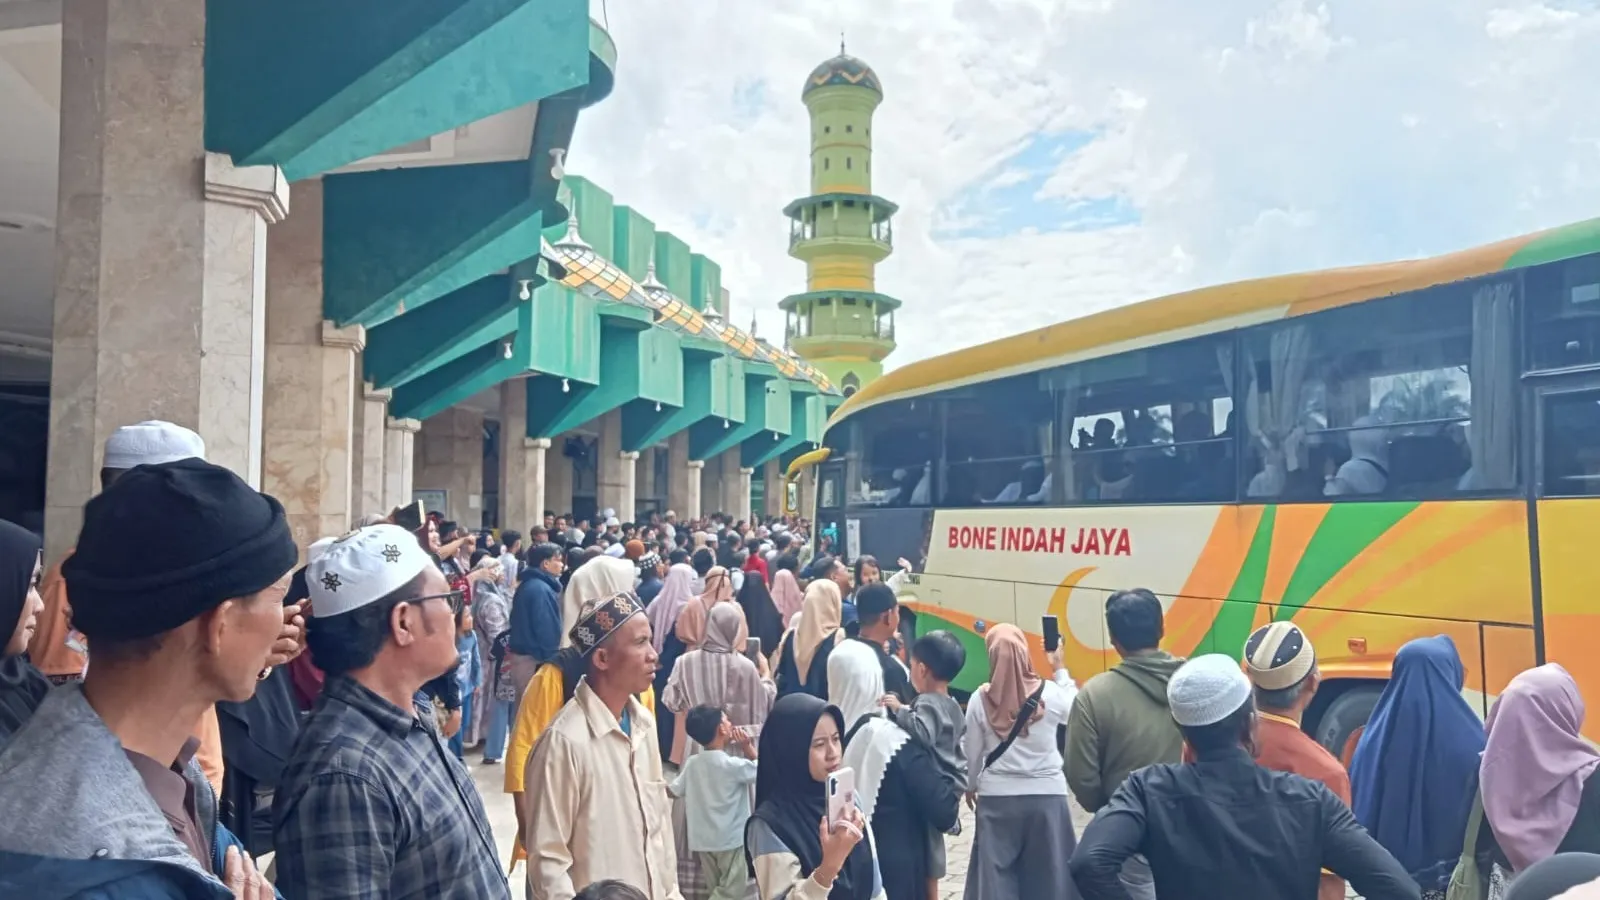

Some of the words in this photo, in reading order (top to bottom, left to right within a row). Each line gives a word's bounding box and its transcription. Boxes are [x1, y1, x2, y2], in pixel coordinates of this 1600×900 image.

[948, 526, 996, 550] BONE
[1000, 527, 1066, 553] INDAH
[1070, 528, 1132, 556] JAYA
